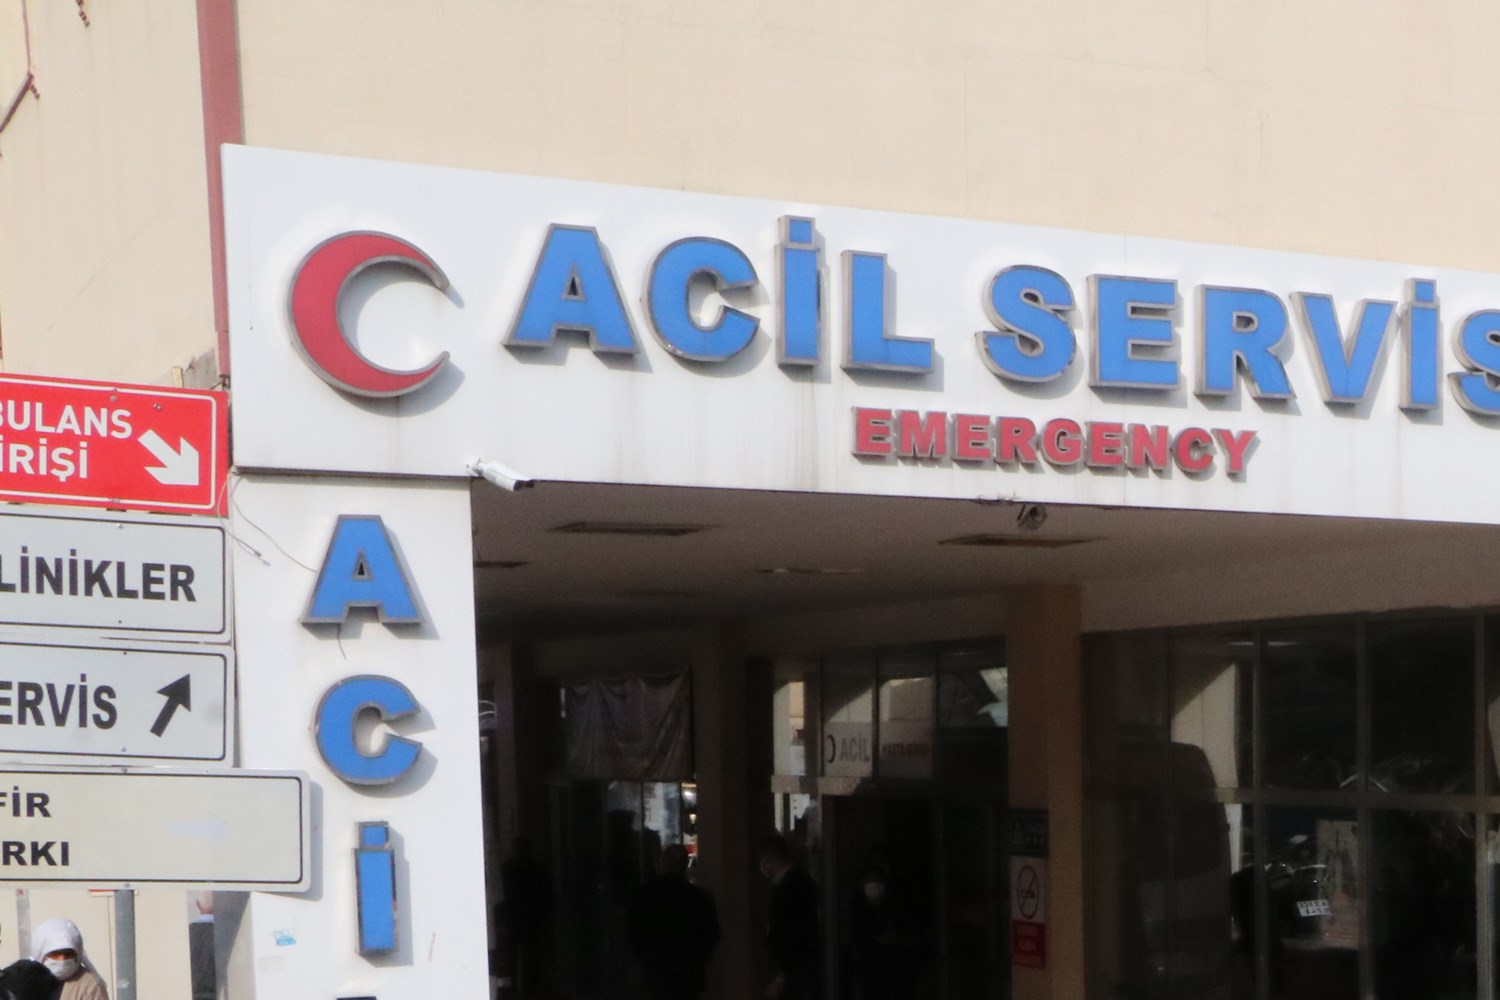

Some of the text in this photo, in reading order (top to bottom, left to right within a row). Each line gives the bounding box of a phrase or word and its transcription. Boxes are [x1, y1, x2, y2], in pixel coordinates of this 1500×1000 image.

[503, 214, 935, 374] ACİL
[0, 397, 133, 440] ULANS
[851, 406, 1258, 474] EMERGENCY
